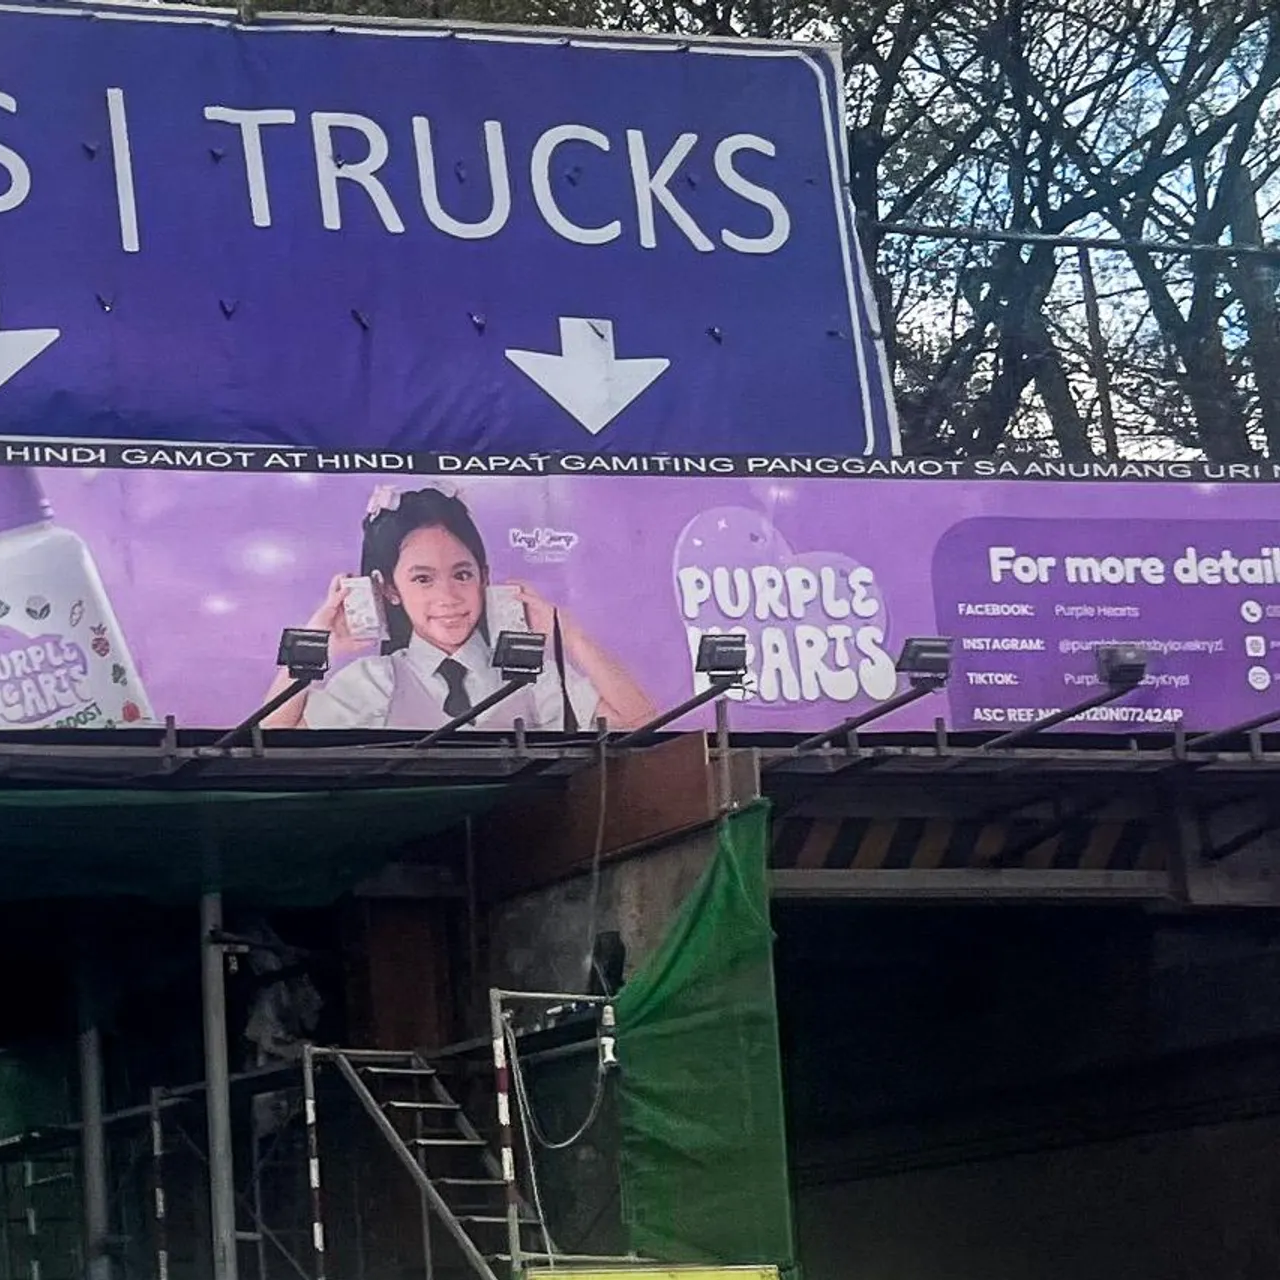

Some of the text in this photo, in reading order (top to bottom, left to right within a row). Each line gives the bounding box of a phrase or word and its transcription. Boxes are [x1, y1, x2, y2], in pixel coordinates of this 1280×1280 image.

[204, 105, 792, 254] TRUCKS
[5, 445, 107, 465] HINDI
[120, 447, 257, 469] GAMOT
[263, 452, 310, 469] AT
[317, 452, 415, 471] HINDI
[438, 454, 552, 473] DAPAT
[559, 454, 736, 474] GAMITING
[746, 456, 964, 477] PANGGAMOT
[1203, 462, 1261, 480] URI
[988, 547, 1056, 584] For
[1064, 555, 1165, 585] more
[677, 565, 880, 620] PURPLE
[958, 603, 1036, 617] FACEBOOK:
[963, 637, 1046, 652] INSTAGRAM:
[973, 707, 1005, 722] ASC
